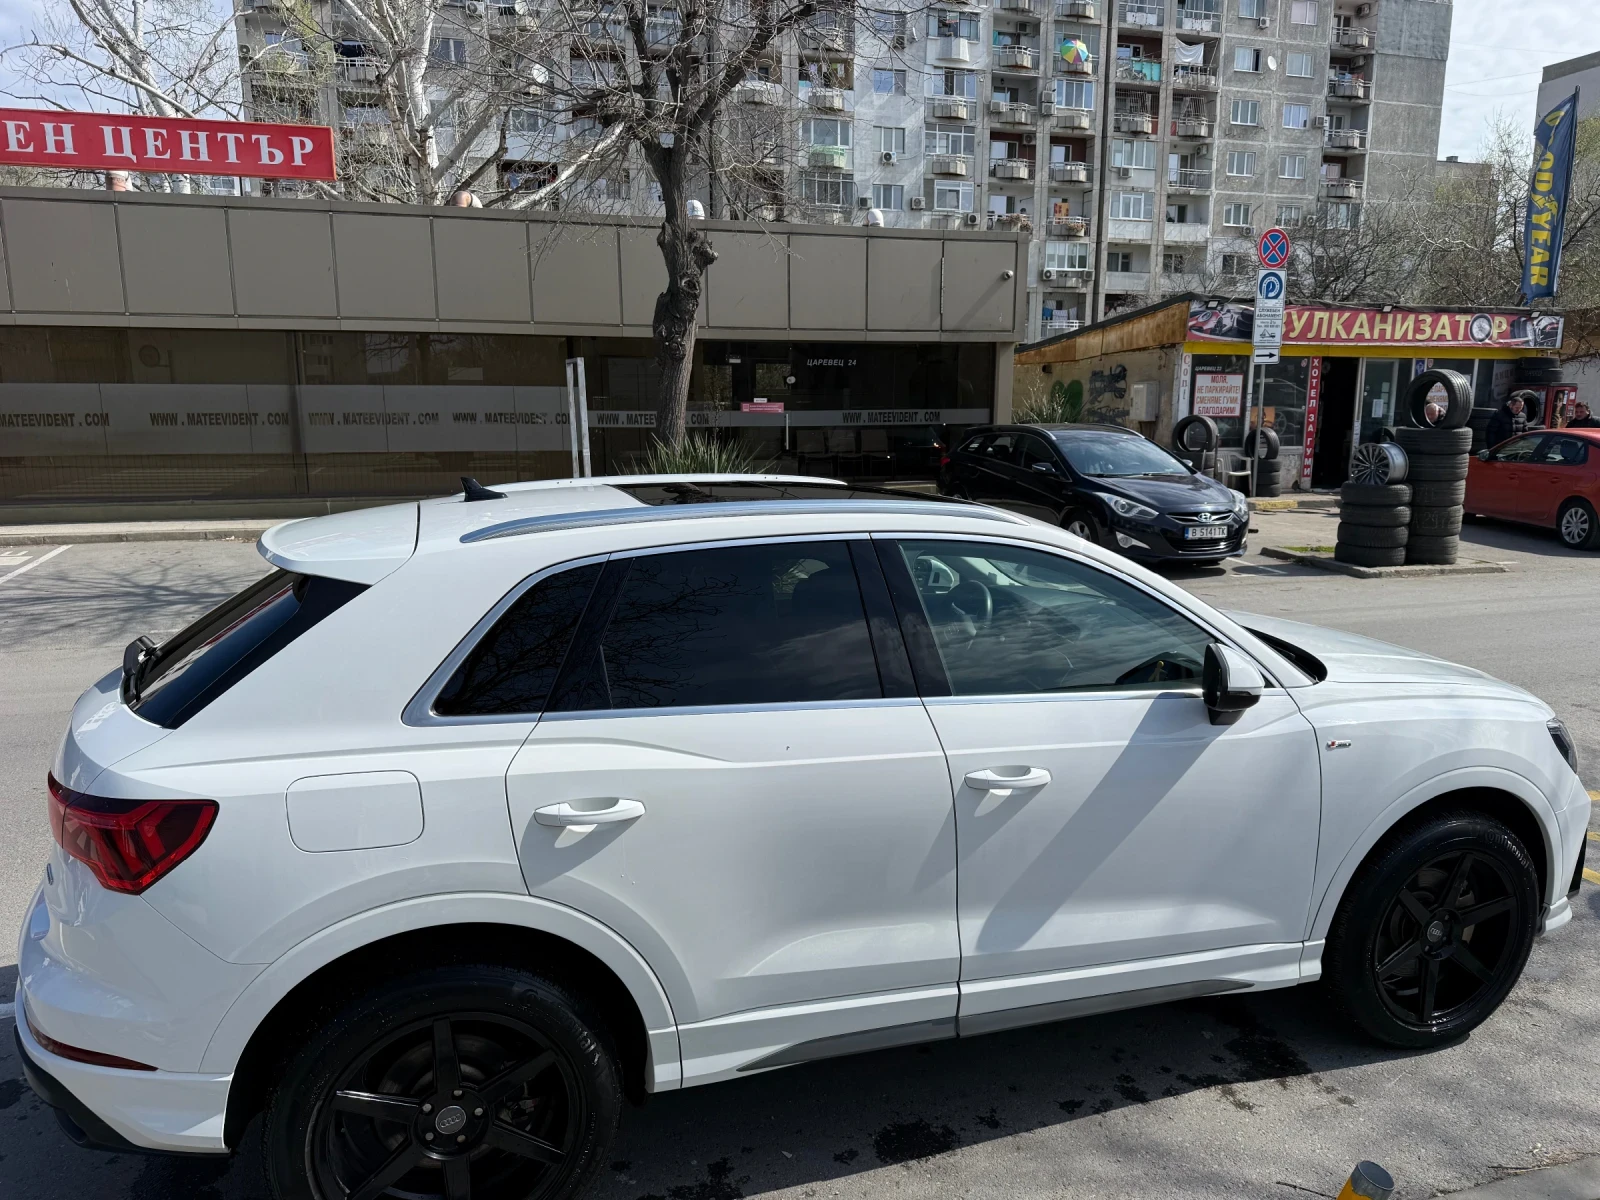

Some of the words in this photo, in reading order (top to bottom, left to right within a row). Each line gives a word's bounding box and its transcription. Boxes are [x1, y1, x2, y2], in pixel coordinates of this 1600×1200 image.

[99, 125, 314, 166] ЦЕНТЪР
[807, 358, 844, 366] ЦАРЕВЕЦ
[1197, 385, 1204, 394] НЕ
[1205, 384, 1240, 394] ПАРКИРАЙТЕ!
[1308, 358, 1319, 408] ХОТЕЛ
[1196, 395, 1222, 404] СМЕНЯМЕ
[1198, 406, 1237, 415] БЛАГОДАРИМ!
[1307, 413, 1315, 432] ЗА
[1303, 438, 1312, 475] ГУМИ
